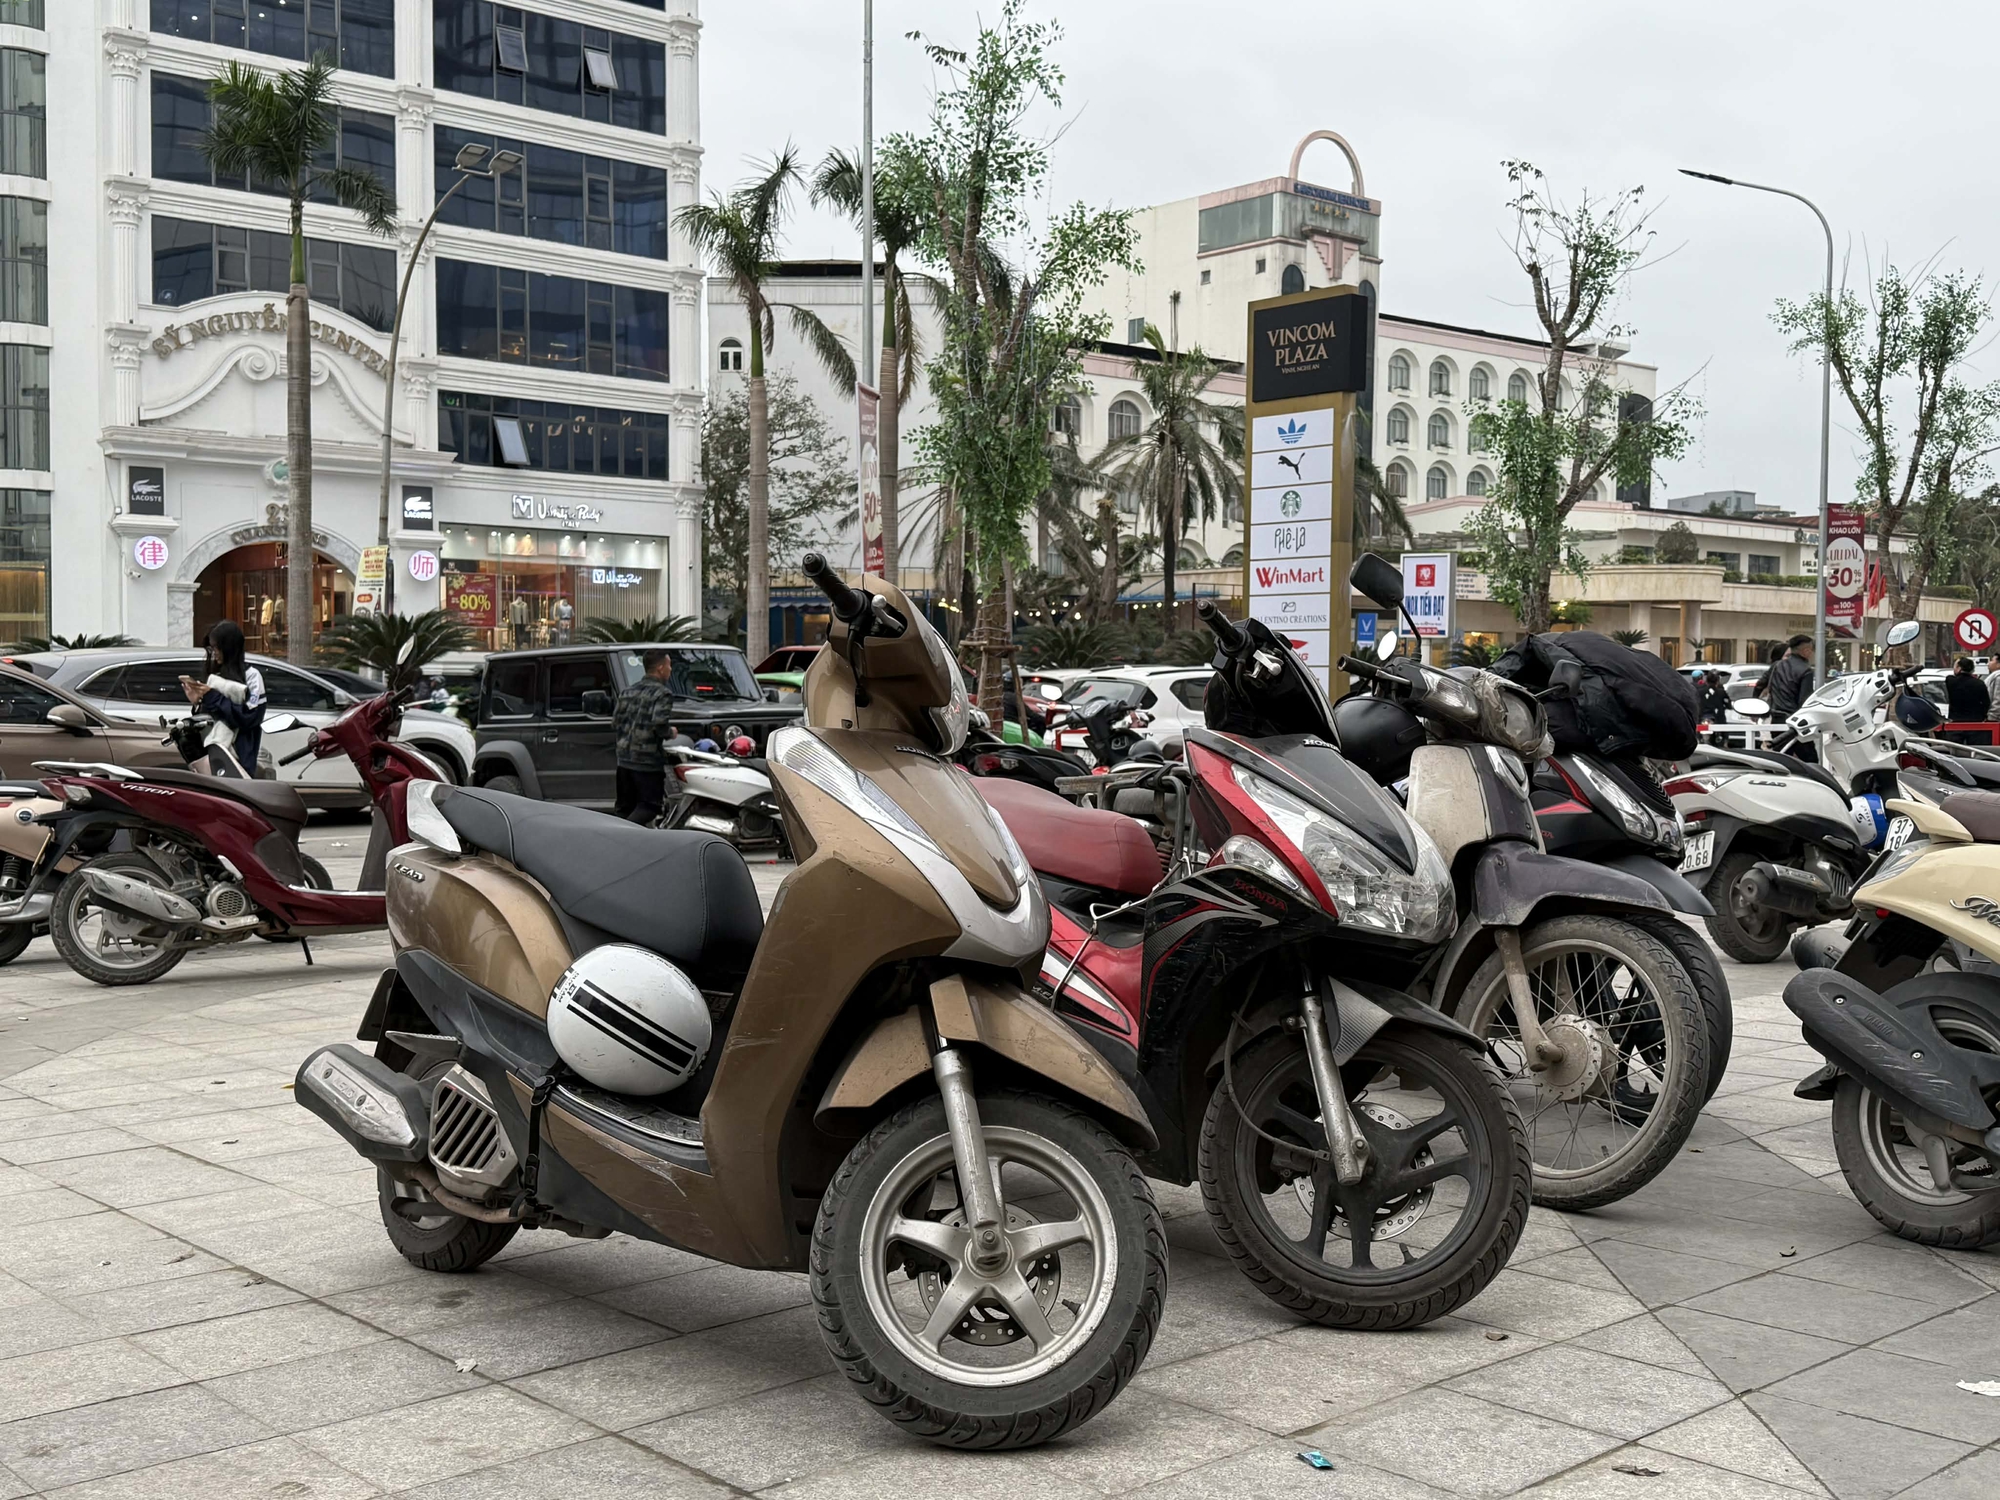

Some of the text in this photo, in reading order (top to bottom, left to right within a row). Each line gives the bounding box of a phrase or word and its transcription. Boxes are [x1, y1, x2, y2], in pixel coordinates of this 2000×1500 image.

[1267, 321, 1336, 347] VINCOM
[1275, 343, 1328, 366] PLAZA
[131, 494, 162, 502] LACOSTE
[139, 541, 164, 565] 律
[413, 554, 434, 577] 师
[1256, 566, 1325, 588] WinMart
[460, 594, 491, 612] 80%
[1257, 614, 1327, 624] LENTINO CREATIONS
[1303, 739, 1341, 753] HONDA
[121, 783, 176, 796] VISION
[1748, 780, 1787, 788] LEAD
[394, 862, 425, 883] LEAD
[1235, 879, 1286, 911] HONDA
[1864, 1013, 1893, 1036] YAMAHA
